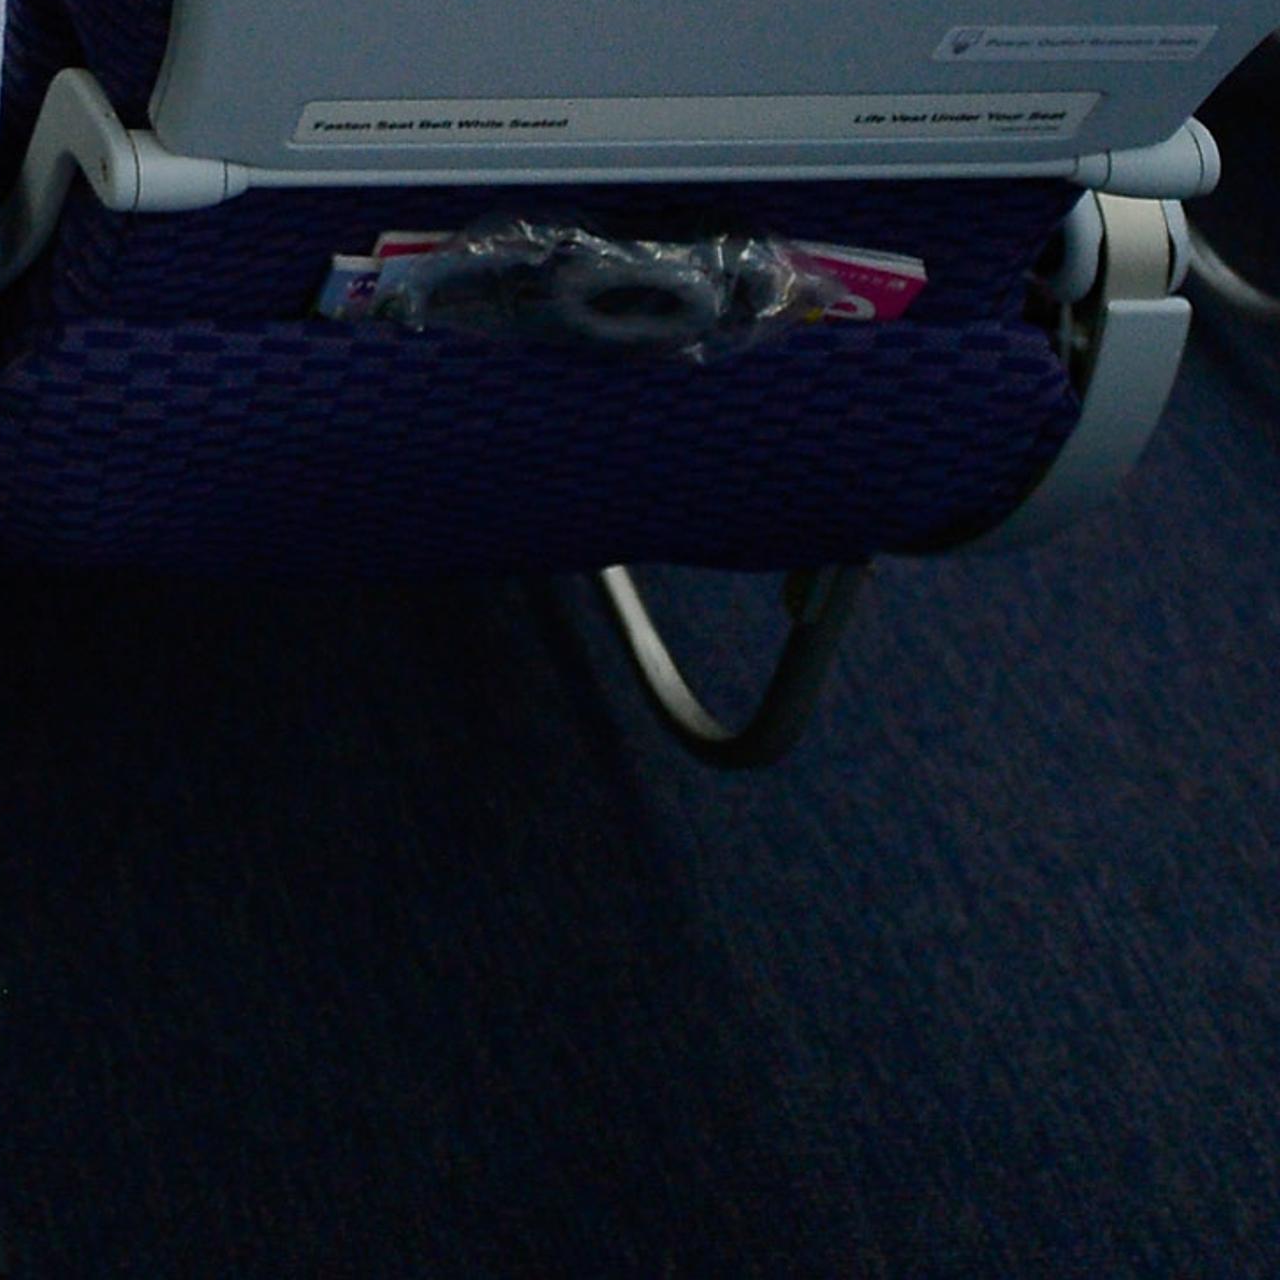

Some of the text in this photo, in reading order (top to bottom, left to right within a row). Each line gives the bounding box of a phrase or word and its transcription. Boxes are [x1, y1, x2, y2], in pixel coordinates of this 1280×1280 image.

[313, 118, 569, 131] Fasten Seat Belt While Seated
